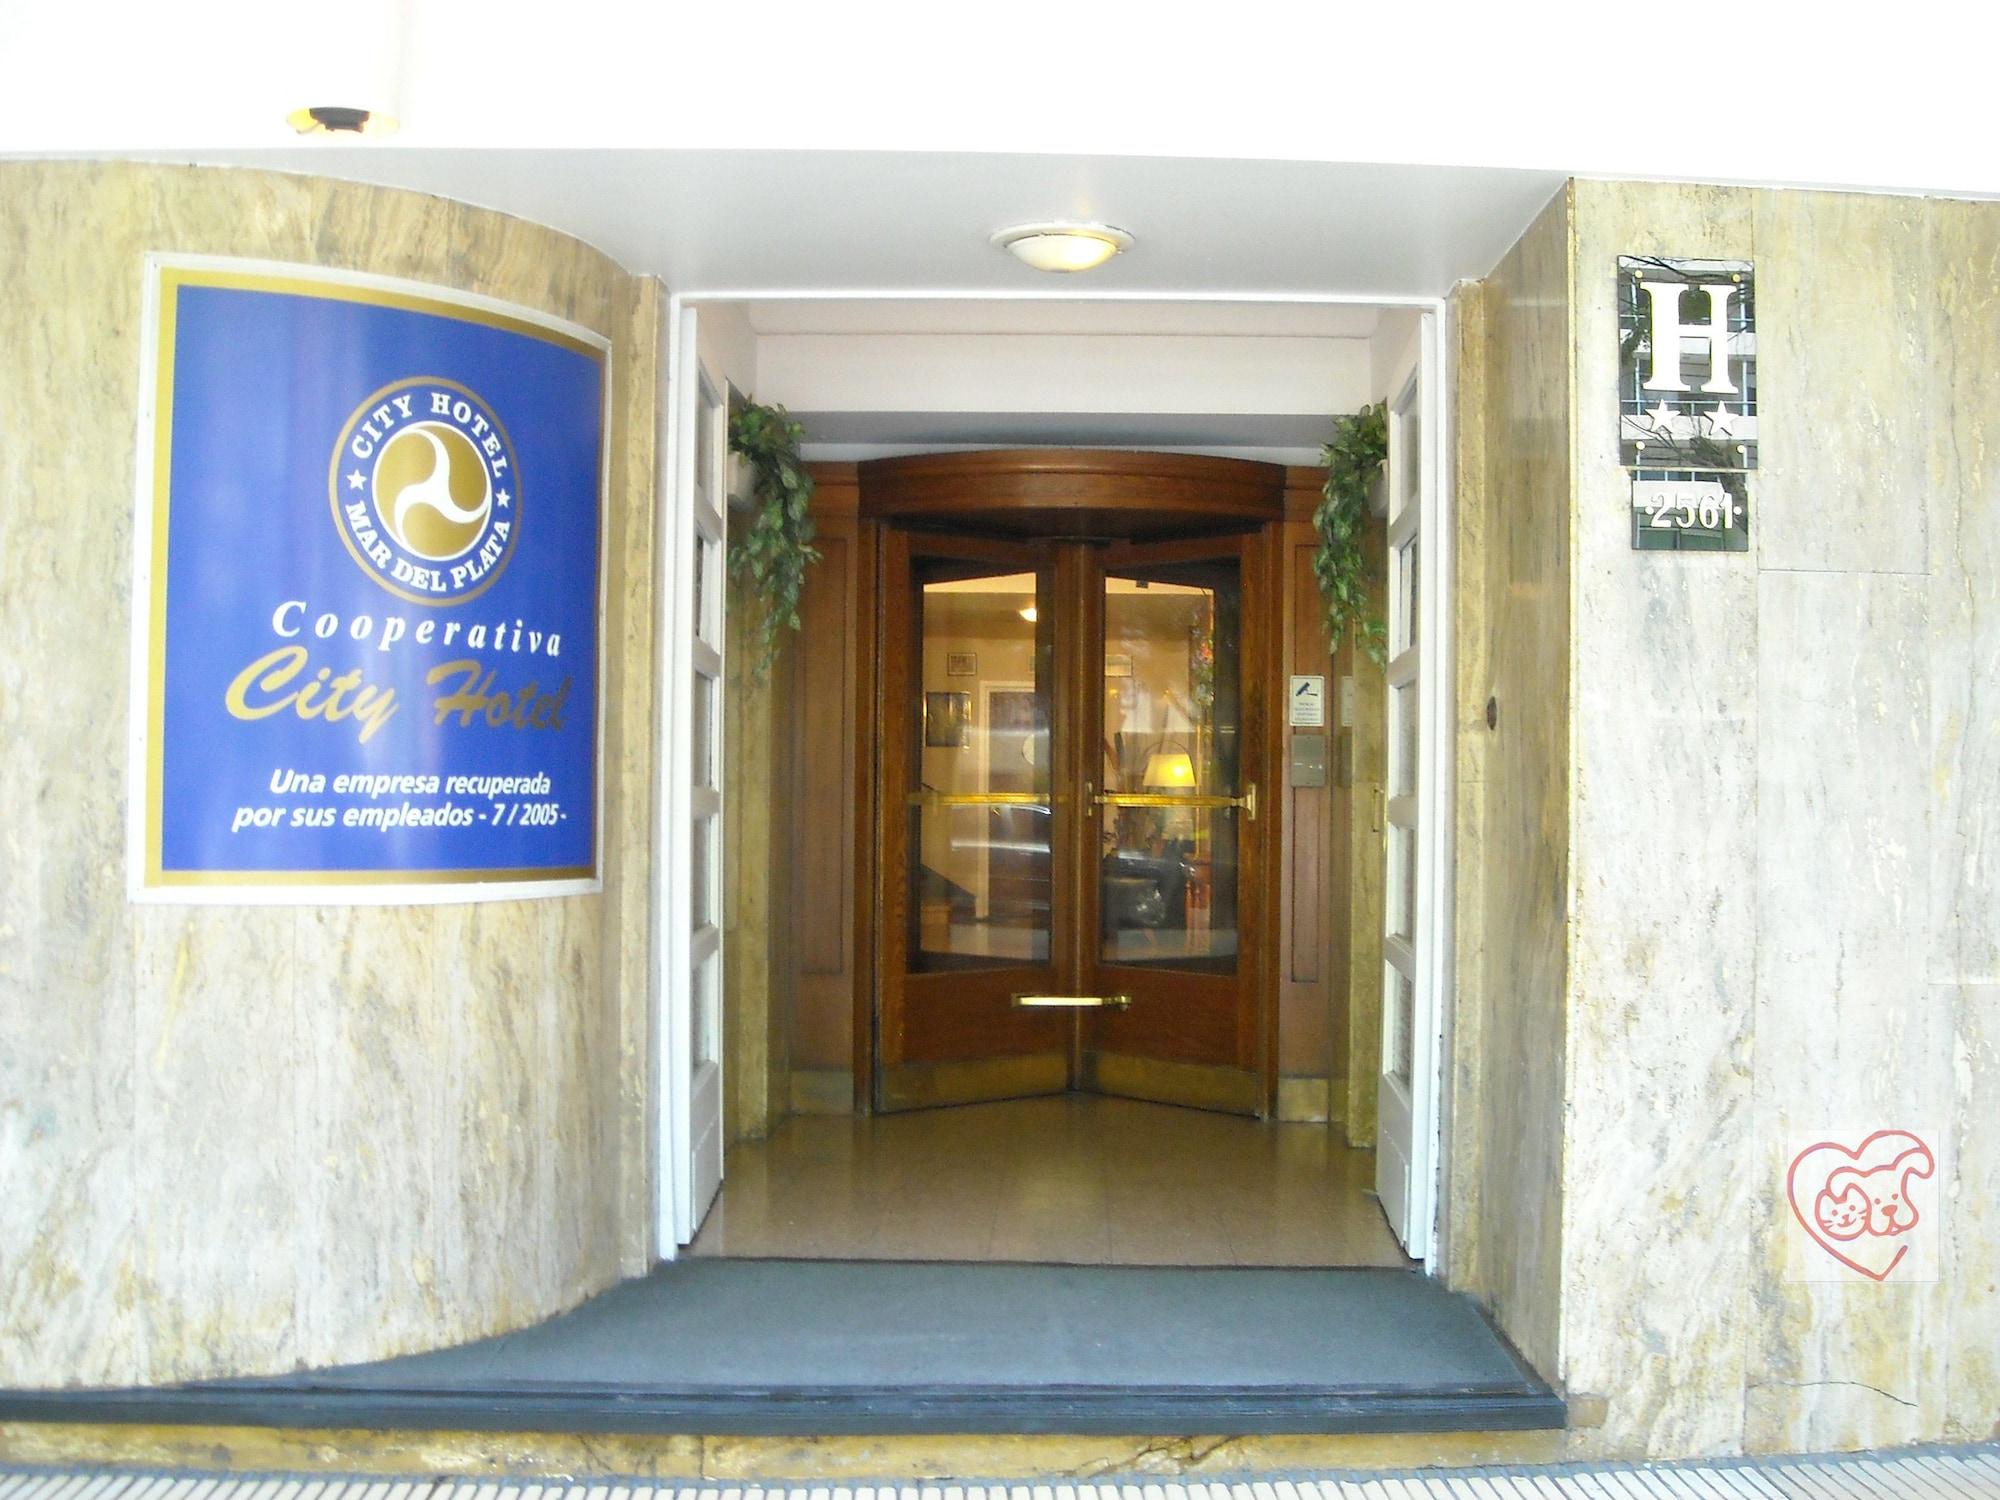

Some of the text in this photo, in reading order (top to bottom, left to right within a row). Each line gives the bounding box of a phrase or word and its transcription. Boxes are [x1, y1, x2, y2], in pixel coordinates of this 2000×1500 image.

[1640, 282, 1739, 393] H
[351, 392, 507, 478] CITY HOTEL
[1649, 491, 1734, 529] 2561
[345, 500, 511, 592] MAR DEL PLATA
[271, 600, 561, 656] Cooperativa
[225, 645, 573, 744] City Hotel
[231, 806, 286, 833] por
[290, 807, 337, 828] sus
[342, 802, 473, 833] empleados
[269, 768, 551, 800] Una empresa recuperada
